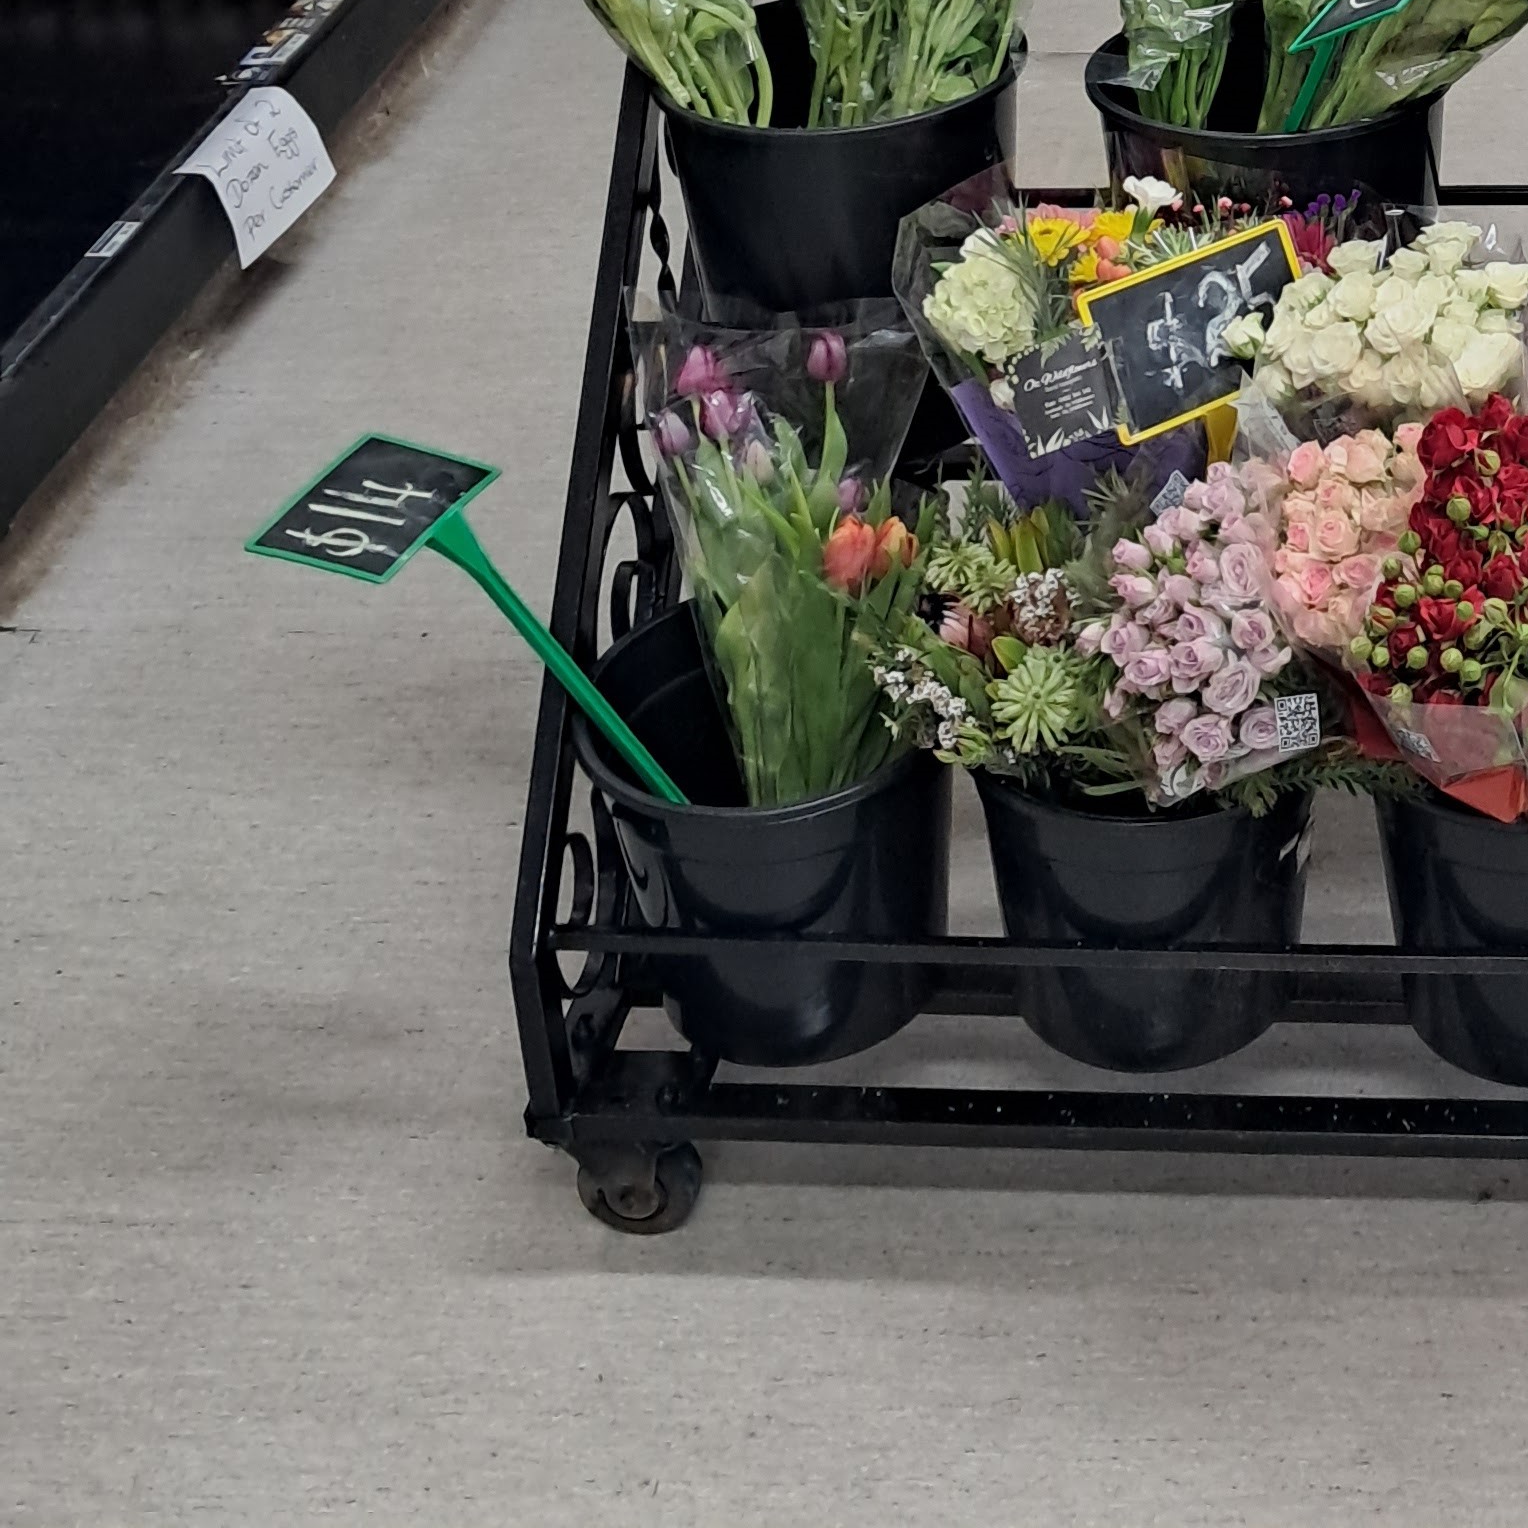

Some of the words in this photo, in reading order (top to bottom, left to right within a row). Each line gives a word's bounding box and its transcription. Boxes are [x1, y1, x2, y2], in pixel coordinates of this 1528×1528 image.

[224, 162, 269, 209] Dozen
[267, 126, 300, 159] Eggs
[285, 478, 437, 557] $14
